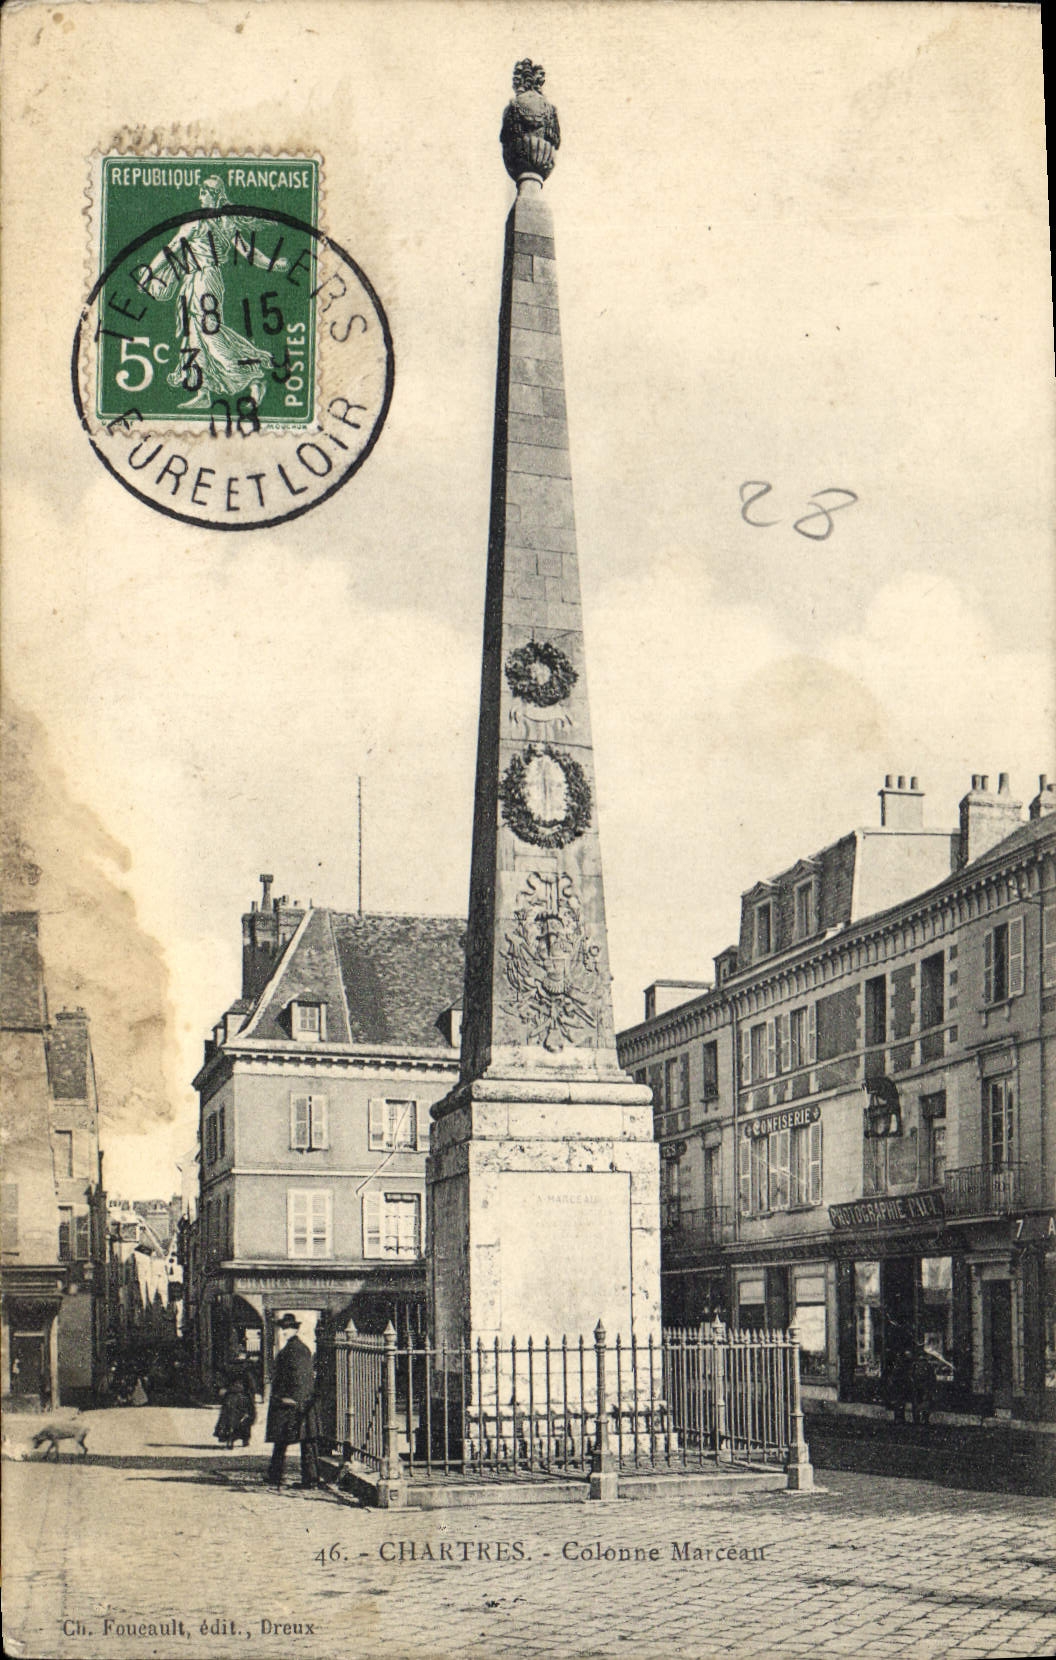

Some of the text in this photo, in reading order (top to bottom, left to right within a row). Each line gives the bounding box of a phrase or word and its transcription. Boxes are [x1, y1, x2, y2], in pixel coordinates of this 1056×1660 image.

[228, 169, 309, 190] FRANÇAISE
[180, 291, 284, 338] 18 15
[180, 348, 204, 392] 3
[285, 322, 306, 407] POSTES
[753, 1107, 811, 1136] CONFISERIE
[547, 1194, 601, 1204] MARCEAU
[829, 1200, 906, 1226] PHOTOGRAPHIE
